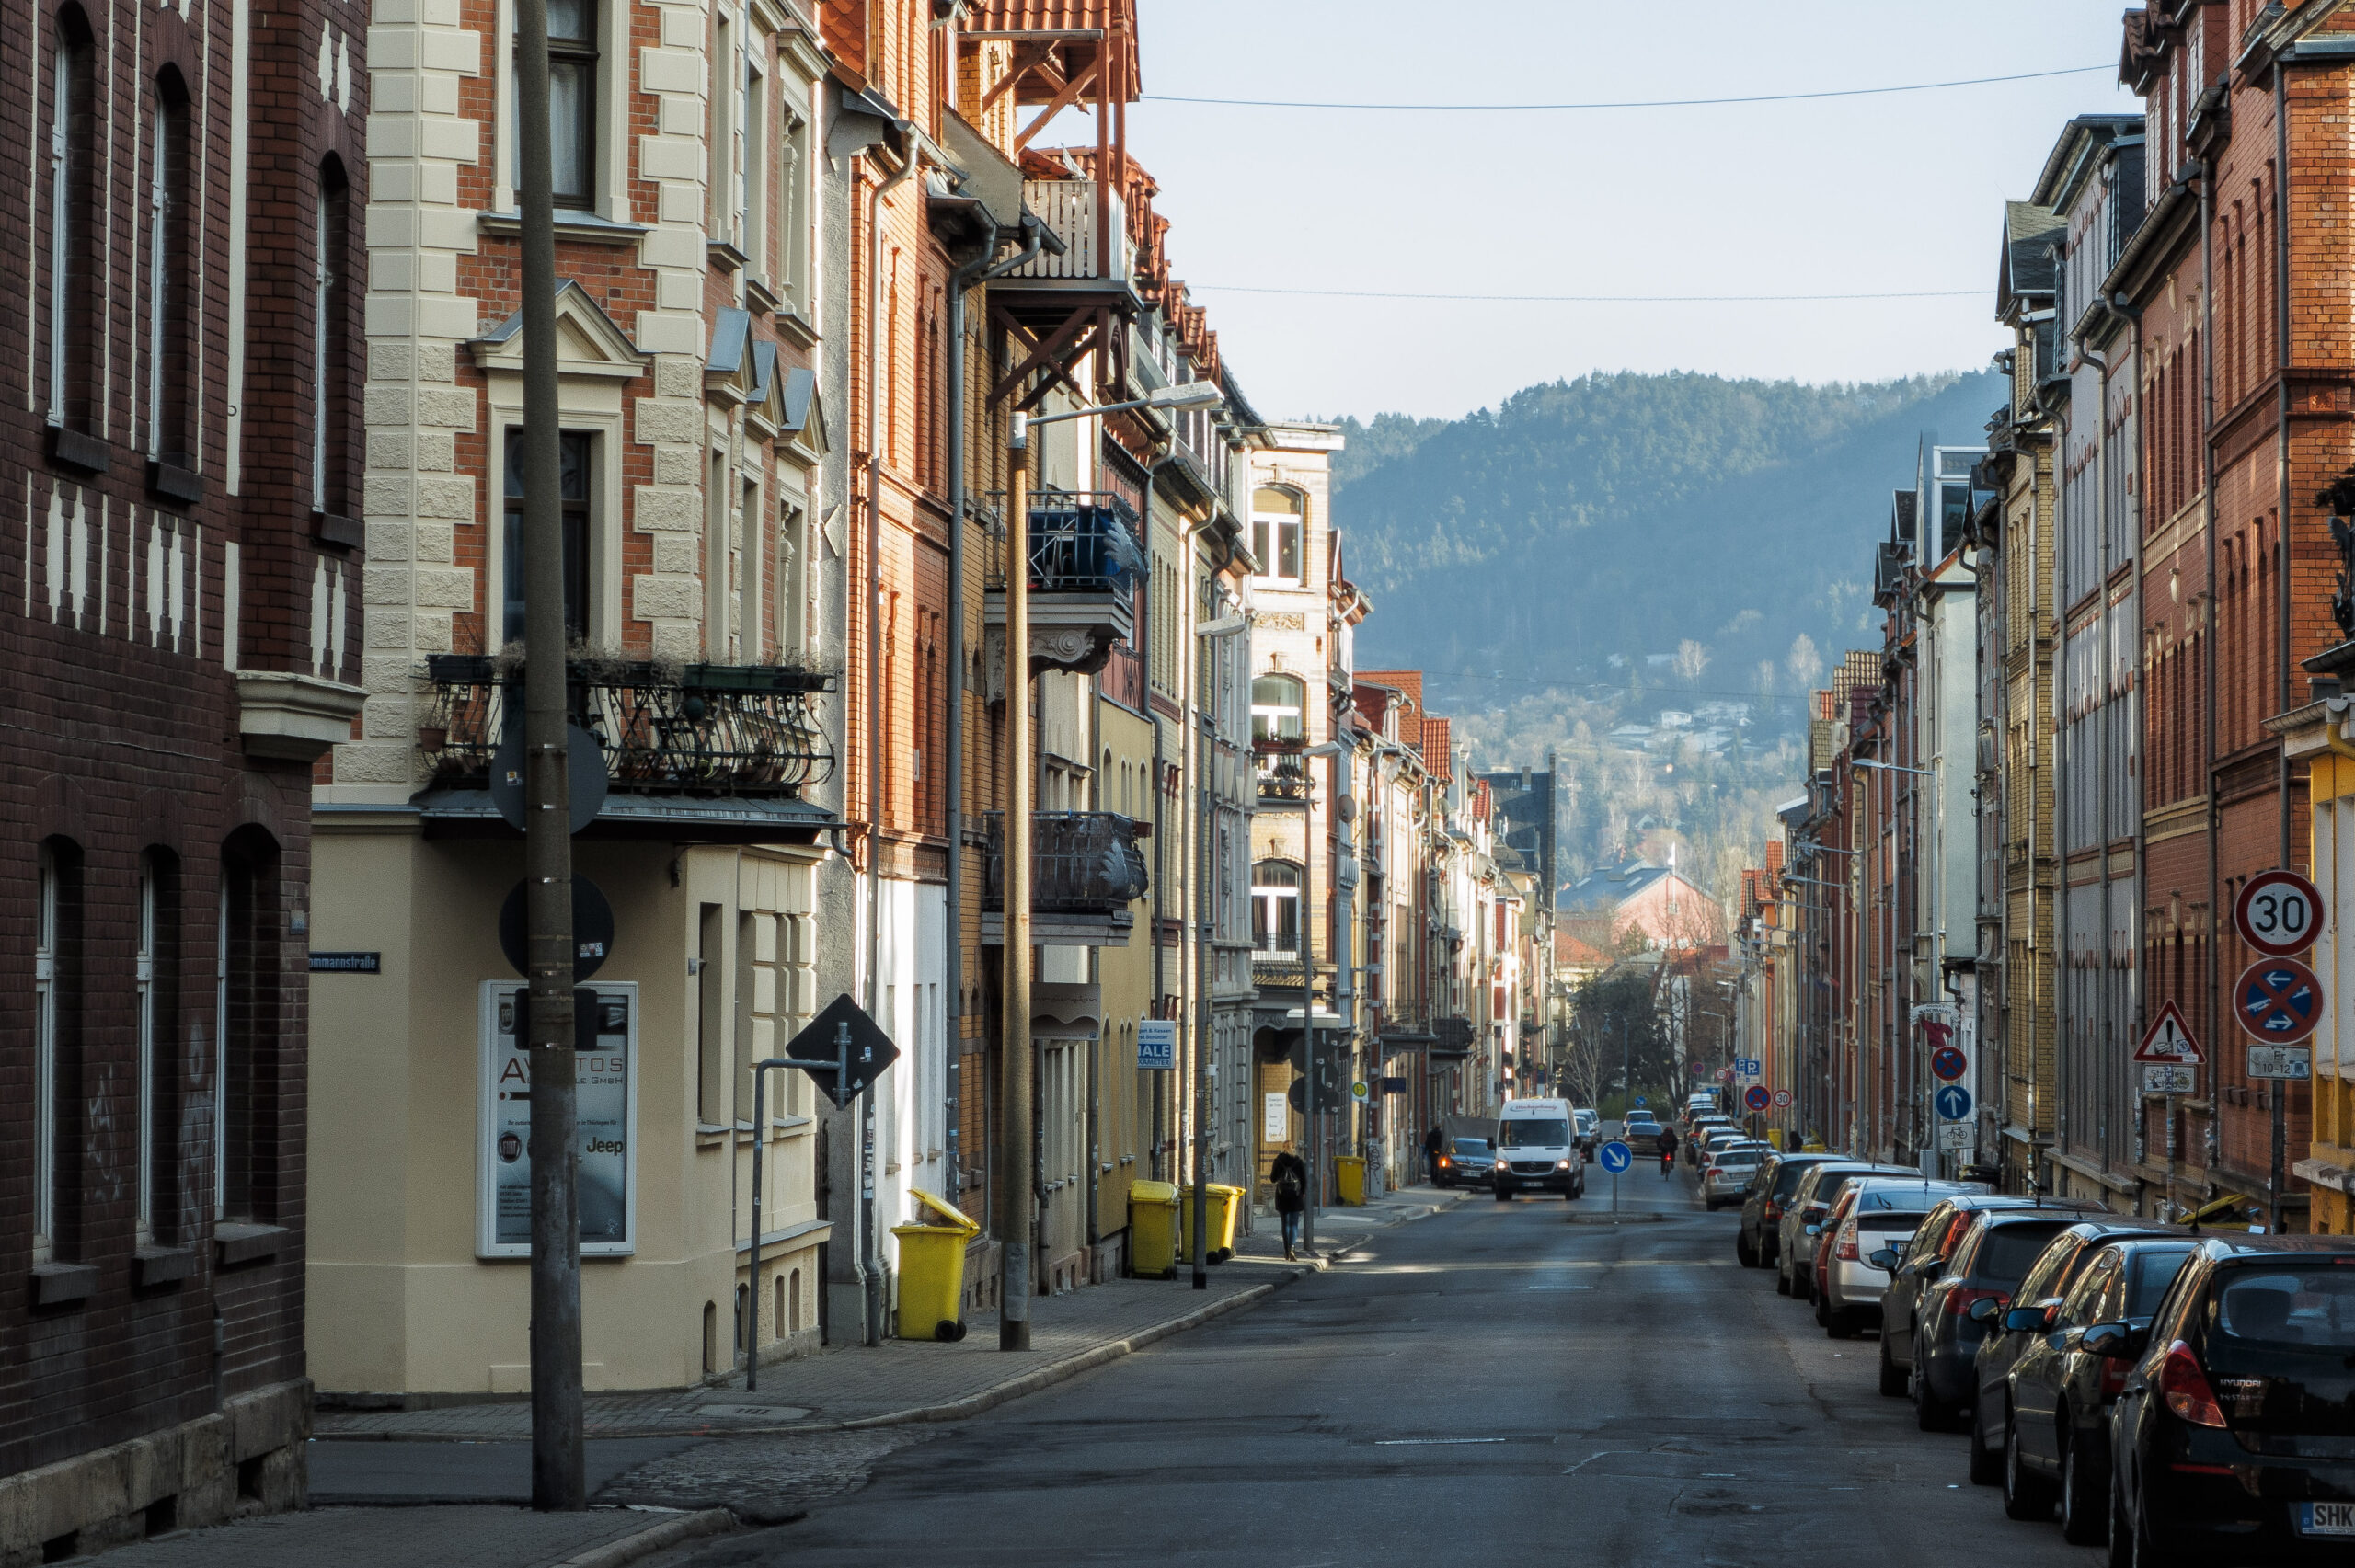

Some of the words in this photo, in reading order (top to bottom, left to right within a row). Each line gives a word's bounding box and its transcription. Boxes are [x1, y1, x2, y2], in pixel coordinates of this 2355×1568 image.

[2256, 895, 2304, 933] 30
[2274, 1050, 2286, 1061] Fr
[1747, 1062, 1757, 1073] P
[1357, 1085, 1363, 1094] H
[1776, 1094, 1788, 1104] 30
[586, 1137, 624, 1156] Jeep
[2219, 1378, 2261, 1388] HYUNDAI
[2315, 1505, 2354, 1527] SHK
